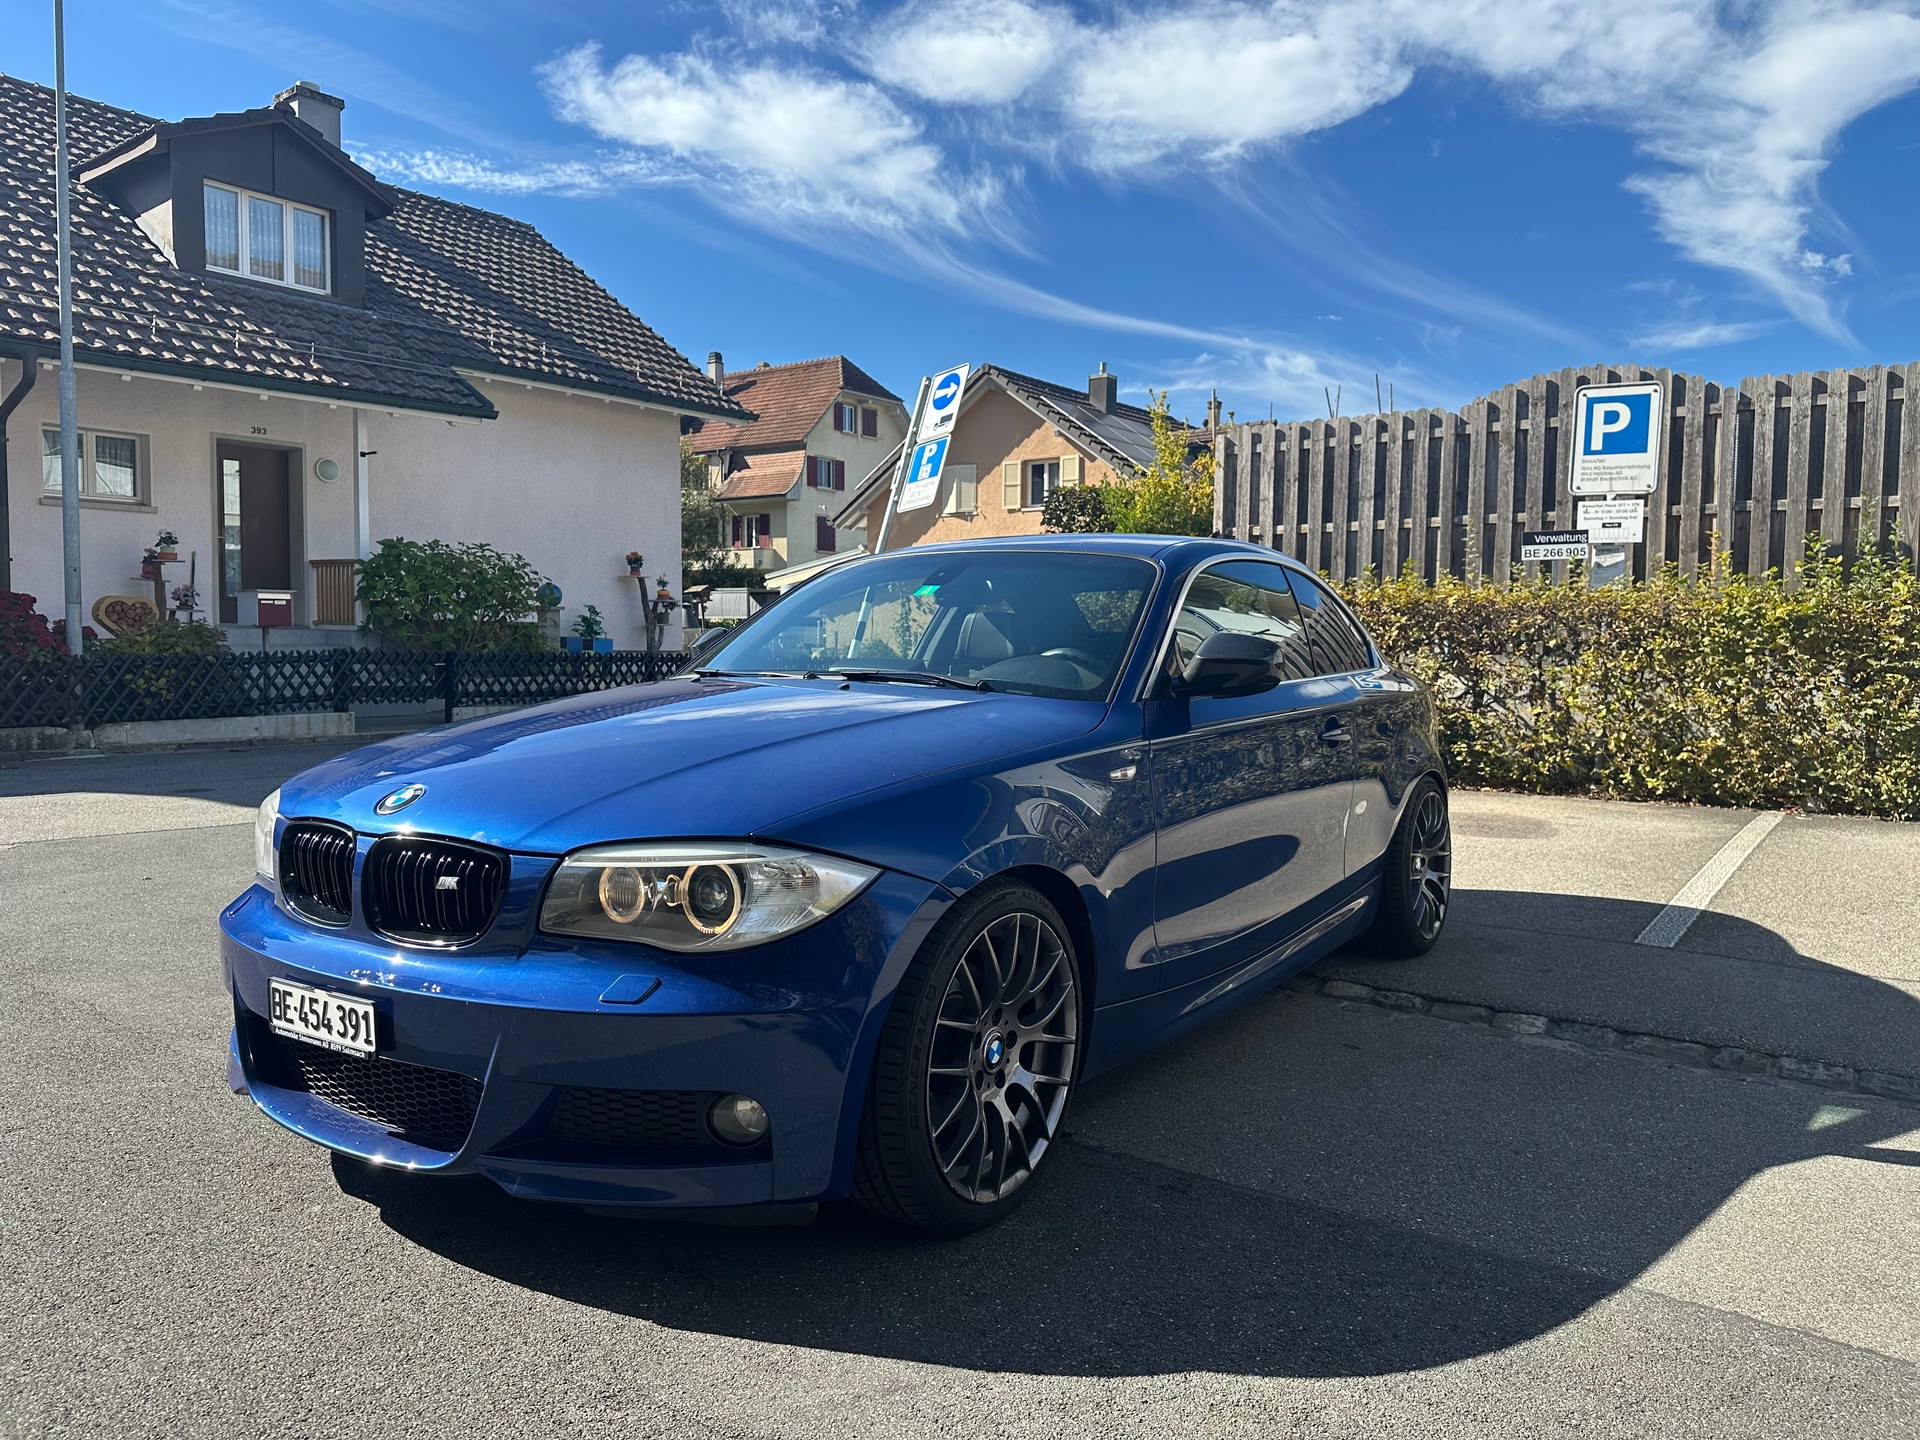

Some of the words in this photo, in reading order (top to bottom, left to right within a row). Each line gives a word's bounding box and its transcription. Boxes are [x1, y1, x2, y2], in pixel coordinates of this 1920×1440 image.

[251, 426, 266, 435] 393
[1591, 402, 1631, 451] P
[921, 443, 938, 465] P
[1534, 533, 1587, 543] Verwaltung
[1524, 549, 1540, 558] BE
[1543, 548, 1563, 557] 266
[1565, 547, 1586, 557] 905
[336, 1004, 374, 1046] 391
[275, 1027, 299, 1040] Automobile
[299, 1034, 322, 1047] Steinmann
[322, 1041, 329, 1049] AG
[330, 1042, 341, 1052] 8599
[342, 1045, 365, 1058] Salmsach
[910, 1011, 930, 1130] GENERAL
